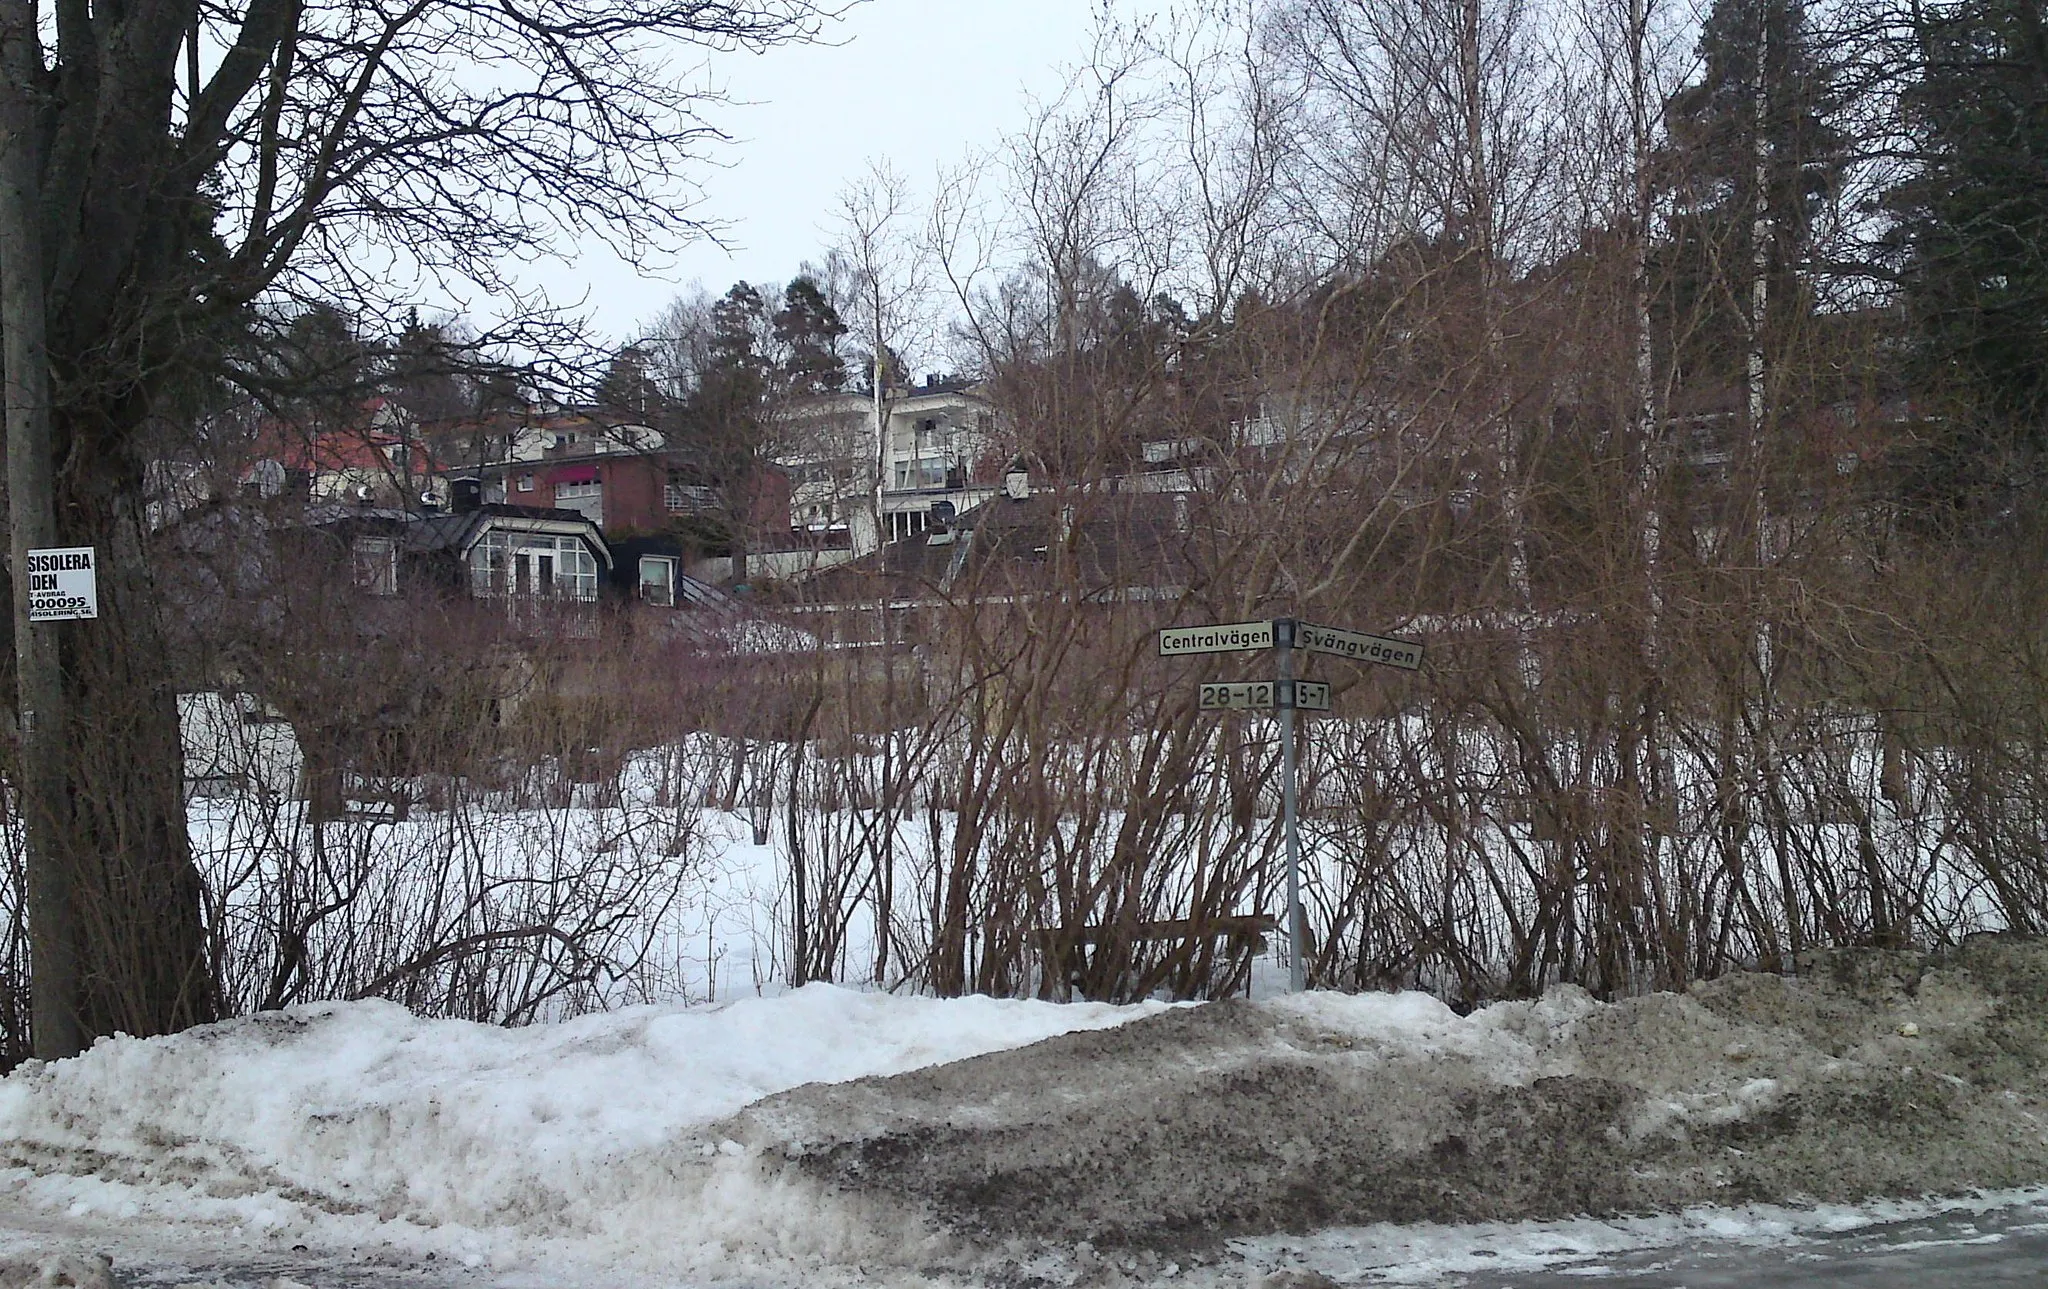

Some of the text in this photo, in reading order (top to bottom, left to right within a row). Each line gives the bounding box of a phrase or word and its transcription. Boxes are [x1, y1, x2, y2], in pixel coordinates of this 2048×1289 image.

[28, 574, 57, 590] DEN
[1163, 630, 1270, 649] Centralvägen
[1303, 630, 1414, 663] Svängvägen
[1202, 685, 1269, 705] 28-12
[1300, 685, 1325, 706] 5-7
